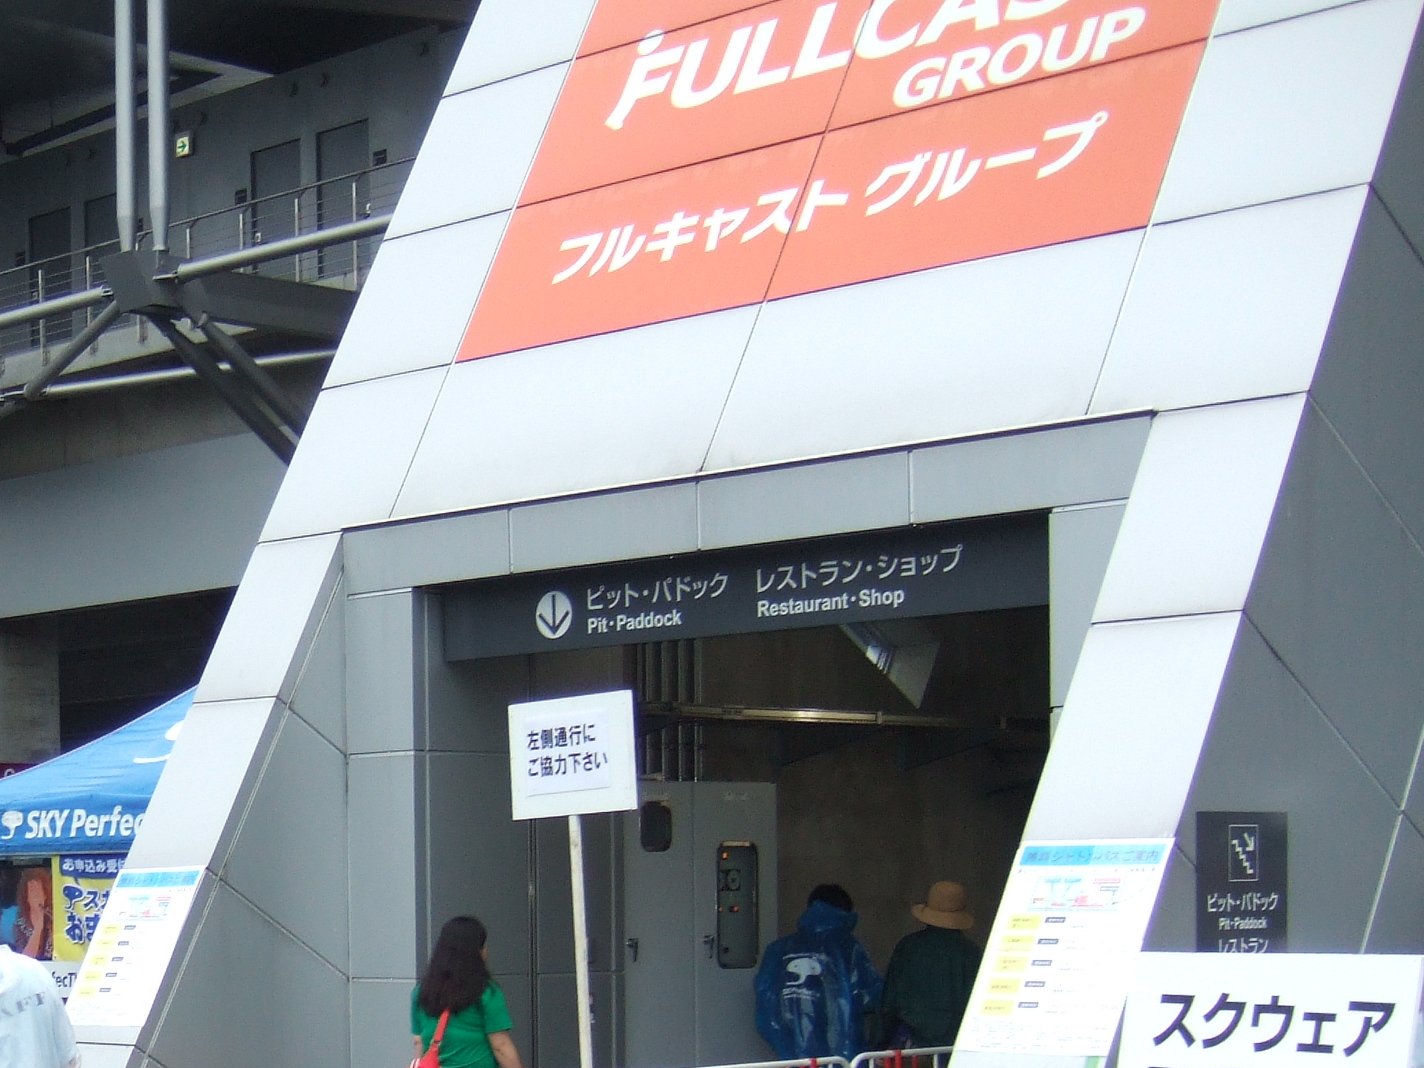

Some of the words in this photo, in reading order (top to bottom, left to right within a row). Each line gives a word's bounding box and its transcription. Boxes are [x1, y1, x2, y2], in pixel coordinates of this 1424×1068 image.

[604, 0, 1068, 130] FULLCA
[893, 7, 1146, 108] GROUP
[552, 180, 849, 284] フルキャスト
[864, 110, 1109, 216] グループ
[756, 544, 963, 593] レストラン・ショップ
[527, 723, 596, 751] 左側通行に
[528, 752, 608, 777] ご協力下さい
[26, 809, 69, 838] SKY
[1219, 937, 1268, 953] レストラン
[1153, 993, 1396, 1057] スクウェア
